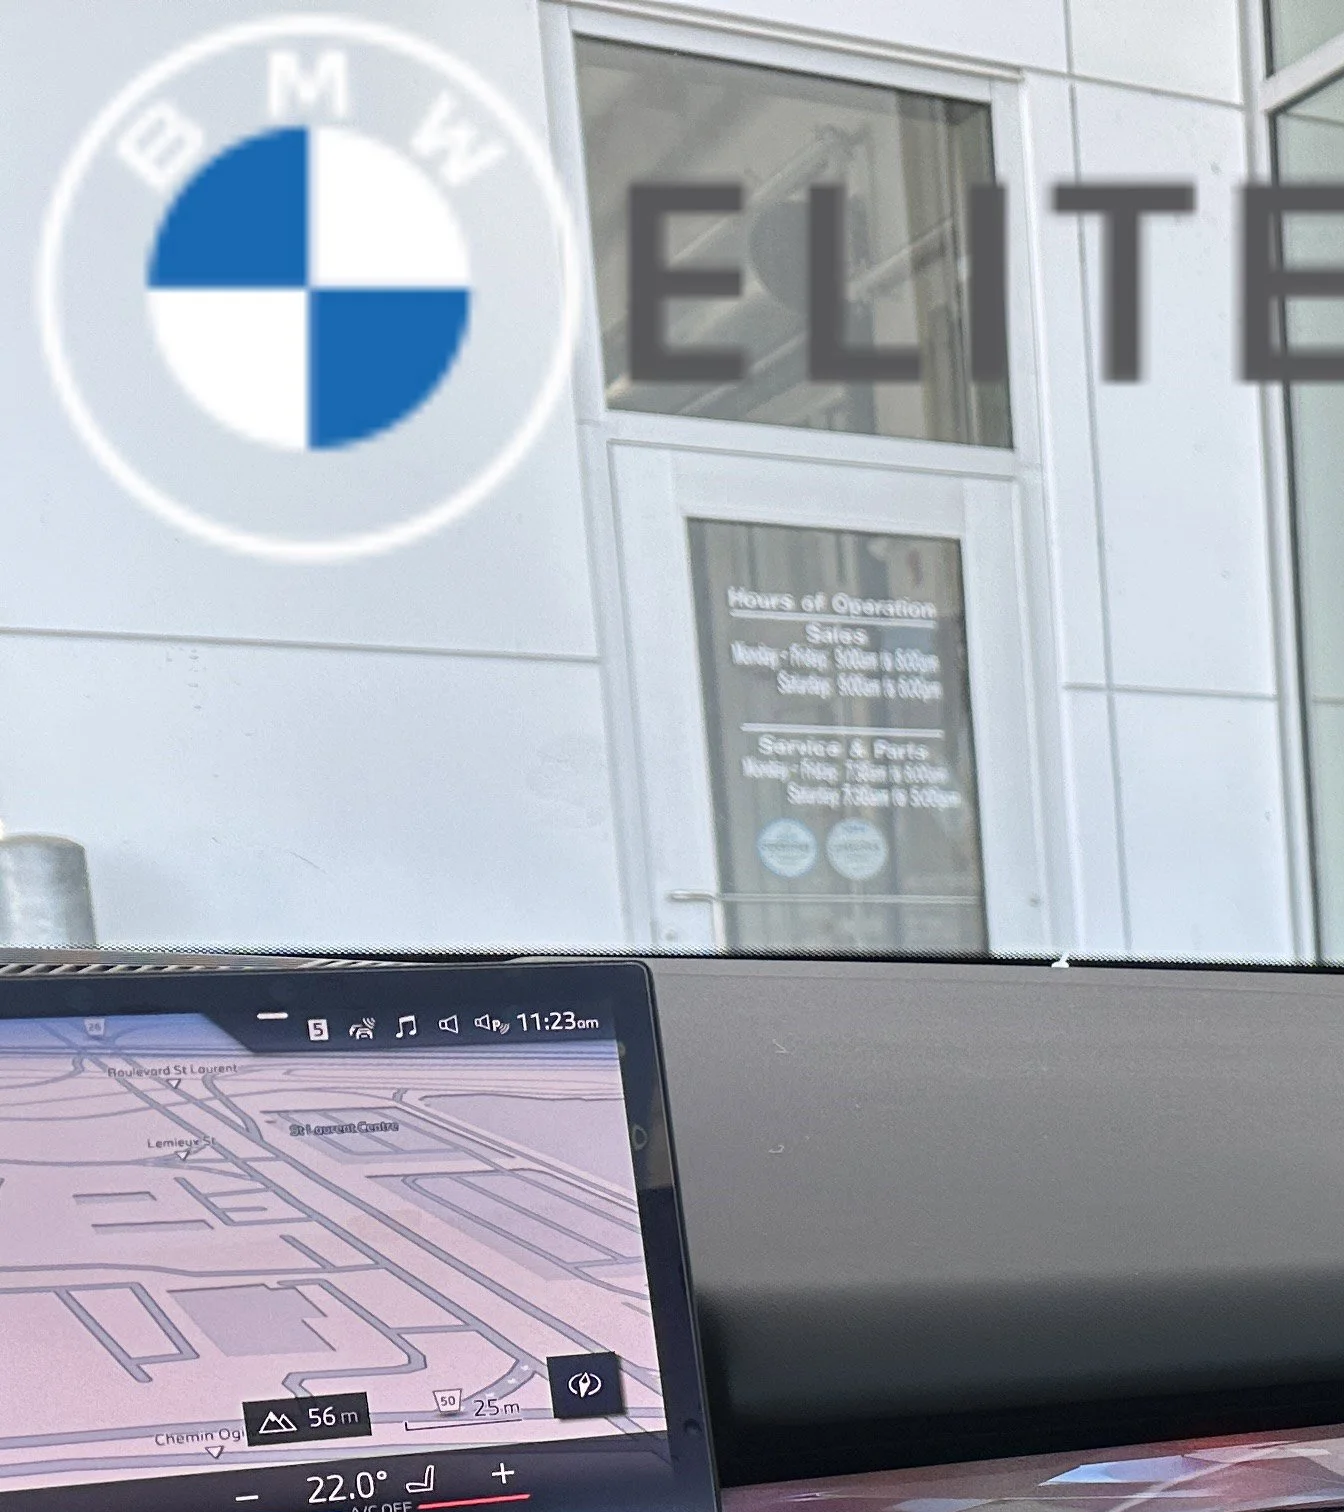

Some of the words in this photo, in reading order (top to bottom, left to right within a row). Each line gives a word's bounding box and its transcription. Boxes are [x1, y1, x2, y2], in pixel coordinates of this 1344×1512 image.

[728, 586, 794, 610] Hours
[801, 591, 827, 612] of
[832, 592, 937, 619] Operation
[805, 622, 869, 645] Sales
[758, 734, 842, 757] Service
[850, 738, 866, 758] &
[873, 739, 929, 760] Parts
[516, 1011, 599, 1032] 11:23am
[107, 1066, 171, 1077] Boulevard
[173, 1064, 187, 1075] St
[190, 1063, 237, 1074] Laurent
[147, 1138, 199, 1148] Lemieux
[439, 1395, 456, 1407] 50
[473, 1399, 500, 1417] 25
[502, 1401, 521, 1415] m
[308, 1406, 337, 1427] 56
[340, 1410, 359, 1426] m
[155, 1432, 214, 1446] Chemin
[306, 1470, 388, 1504] 22.0°
